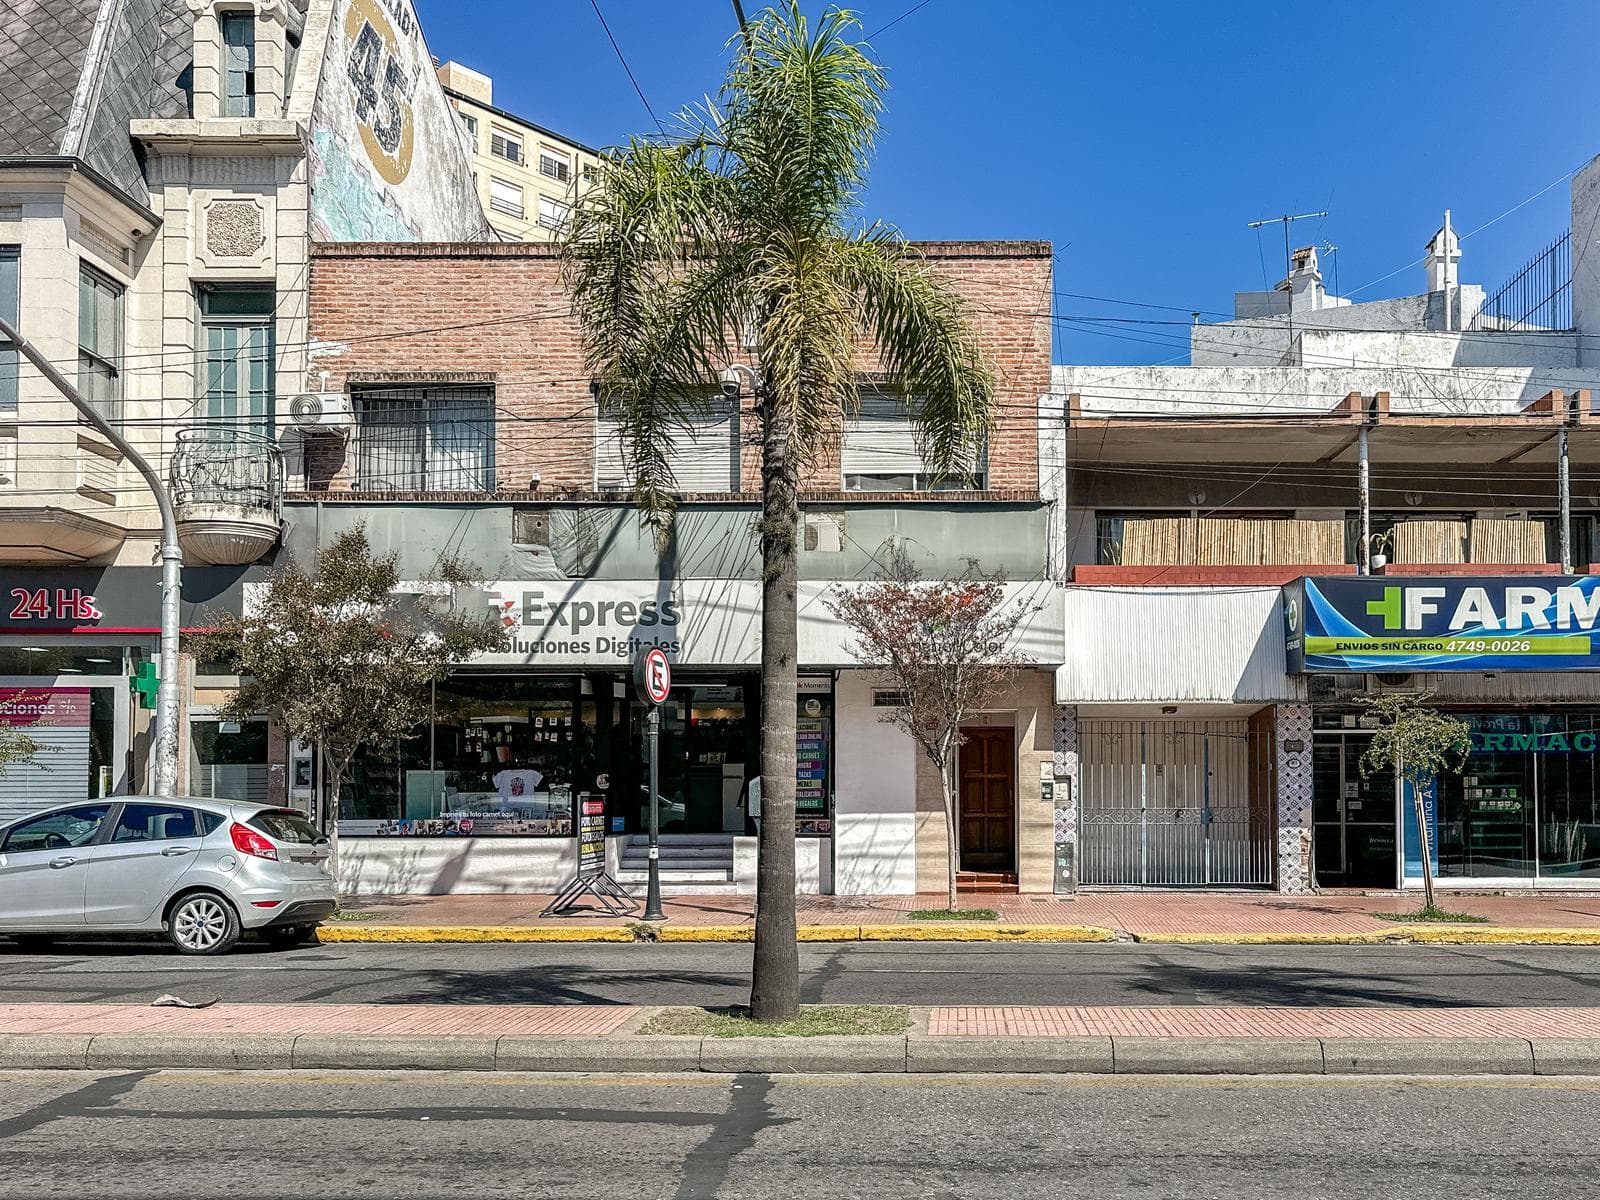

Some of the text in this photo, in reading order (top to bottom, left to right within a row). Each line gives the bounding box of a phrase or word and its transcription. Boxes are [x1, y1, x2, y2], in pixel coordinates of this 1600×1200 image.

[10, 588, 102, 619] 24 Hs.
[522, 591, 681, 635] Express
[1405, 587, 1600, 630] FARM
[488, 637, 591, 654] oluciones
[1336, 640, 1531, 653] ENVIOS SIN CARGO 4749-0026
